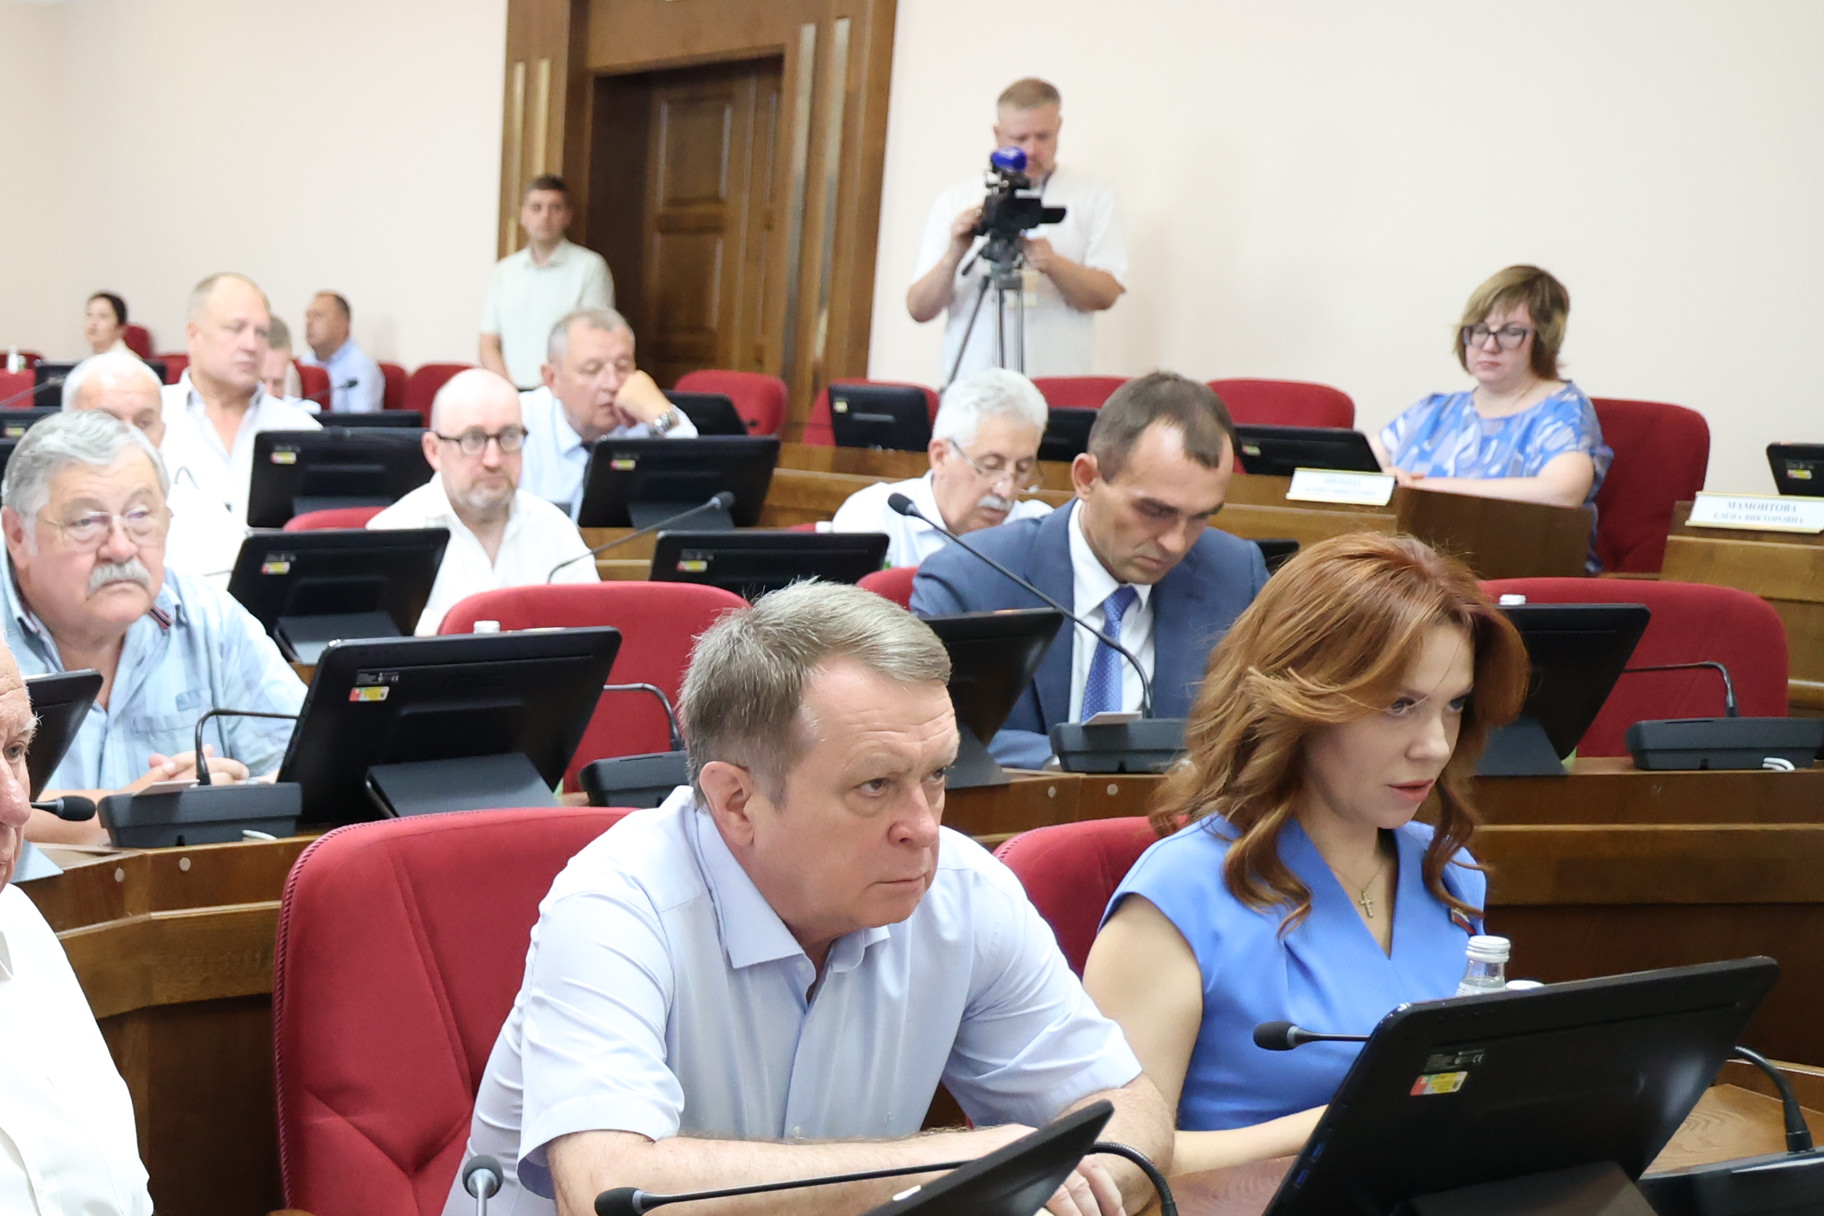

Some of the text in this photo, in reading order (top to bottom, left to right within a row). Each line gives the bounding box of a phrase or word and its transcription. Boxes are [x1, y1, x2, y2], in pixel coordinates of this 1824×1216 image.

[1727, 501, 1797, 513] МАМОНТОВА
[1713, 512, 1804, 524] ЕЛЕНА ВИКТОРОВНА
